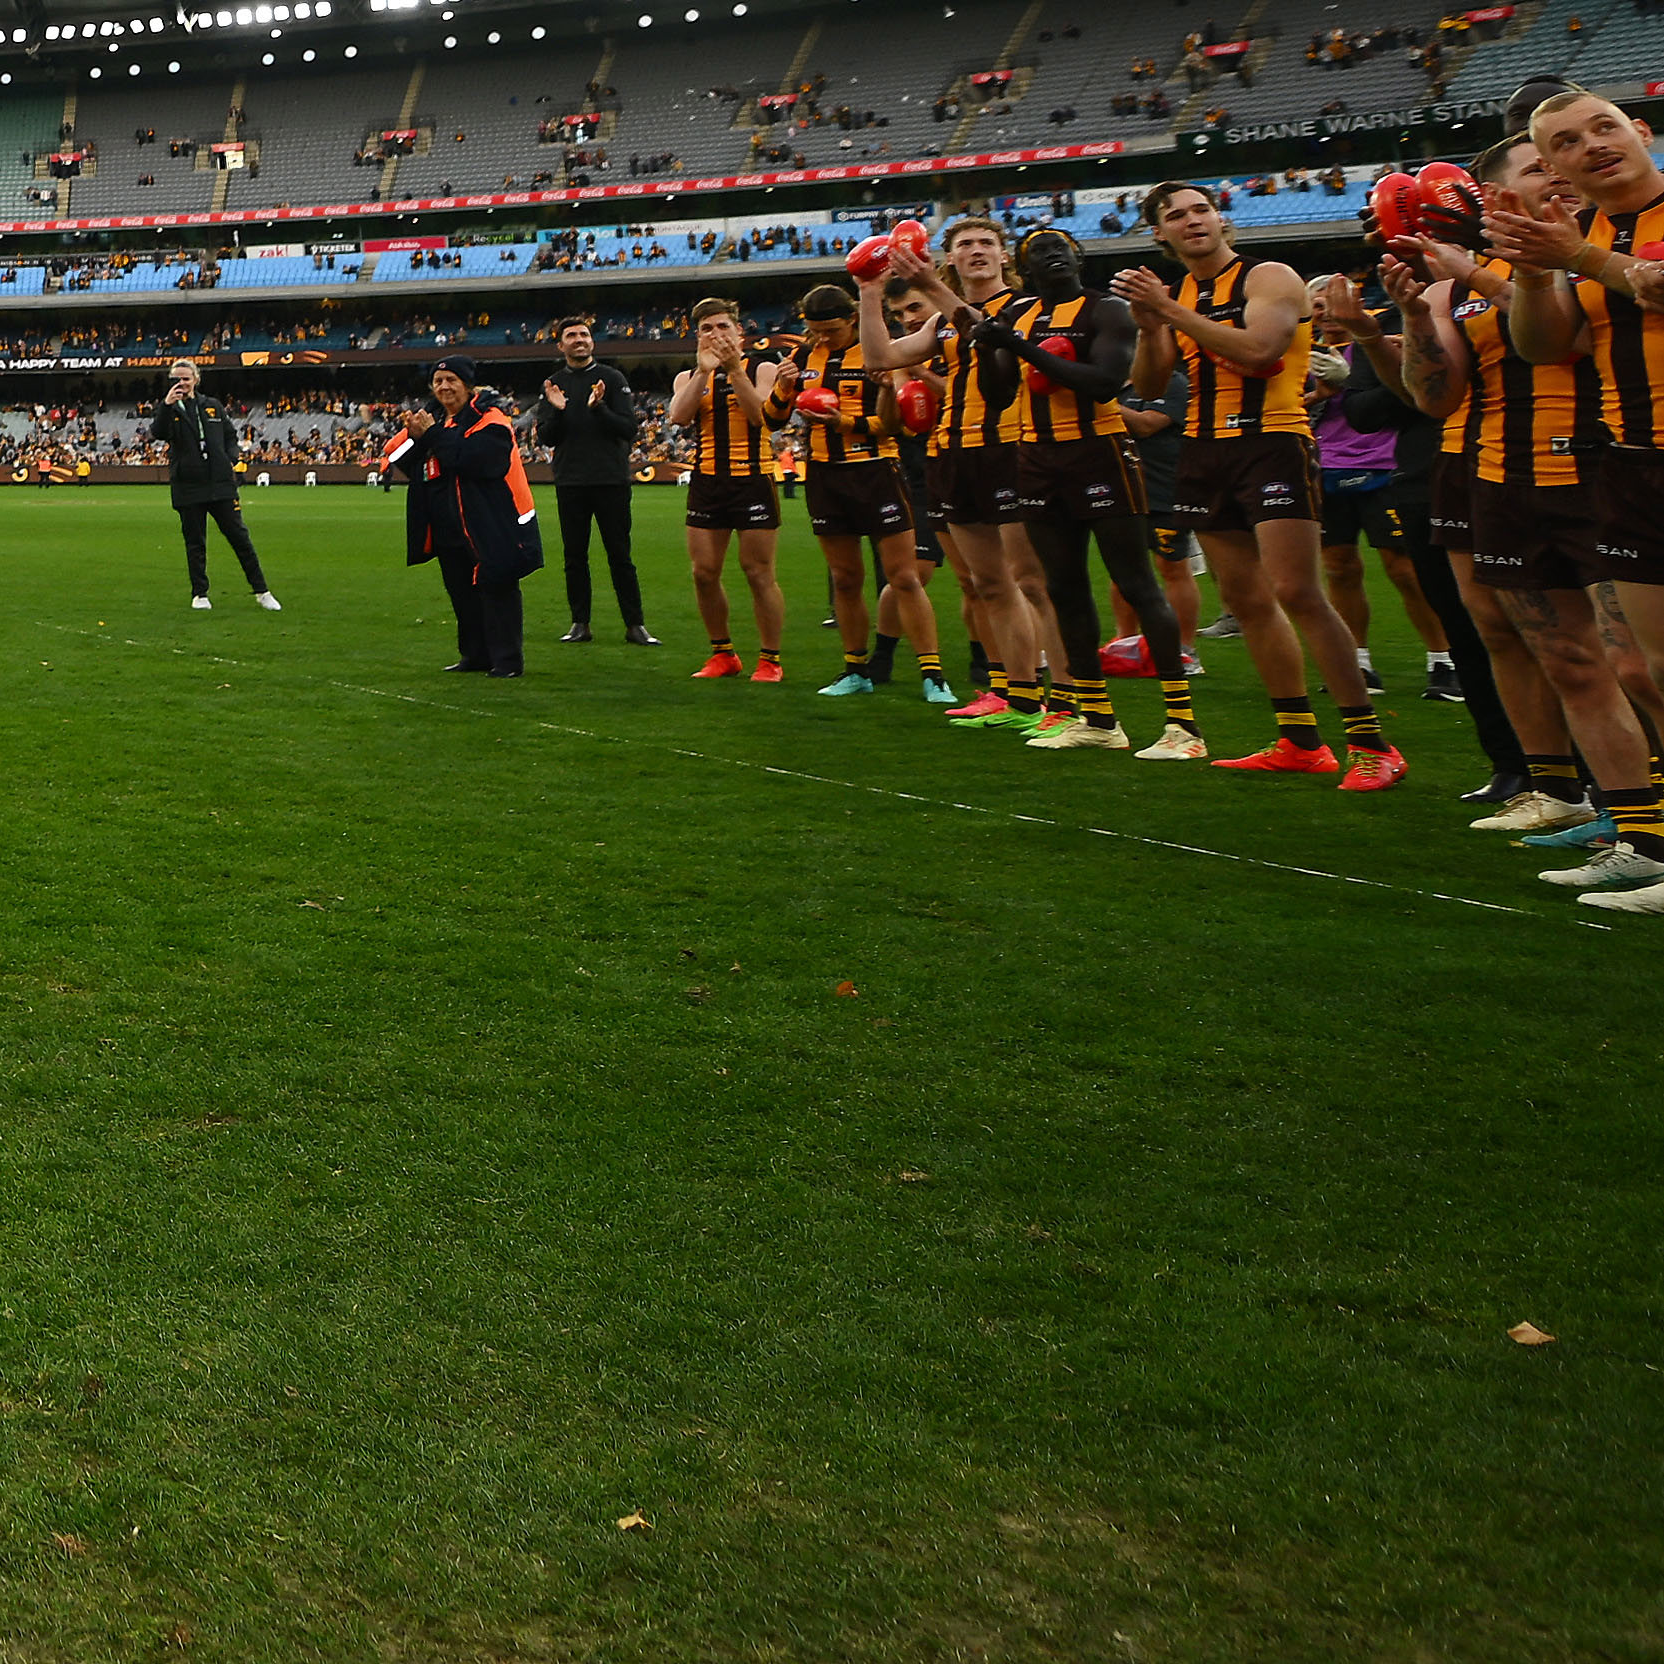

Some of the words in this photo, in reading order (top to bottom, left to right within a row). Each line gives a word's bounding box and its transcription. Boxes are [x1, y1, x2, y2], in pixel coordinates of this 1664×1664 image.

[1225, 120, 1318, 144] SHANE
[1324, 110, 1426, 135] WARNE
[1431, 99, 1506, 122] STAN
[1454, 301, 1488, 318] AFL
[9, 358, 57, 369] HAPPY
[61, 358, 101, 369] TEAM
[104, 357, 123, 368] AT
[1173, 504, 1209, 513] SSAN
[1474, 553, 1522, 566] SSAN
